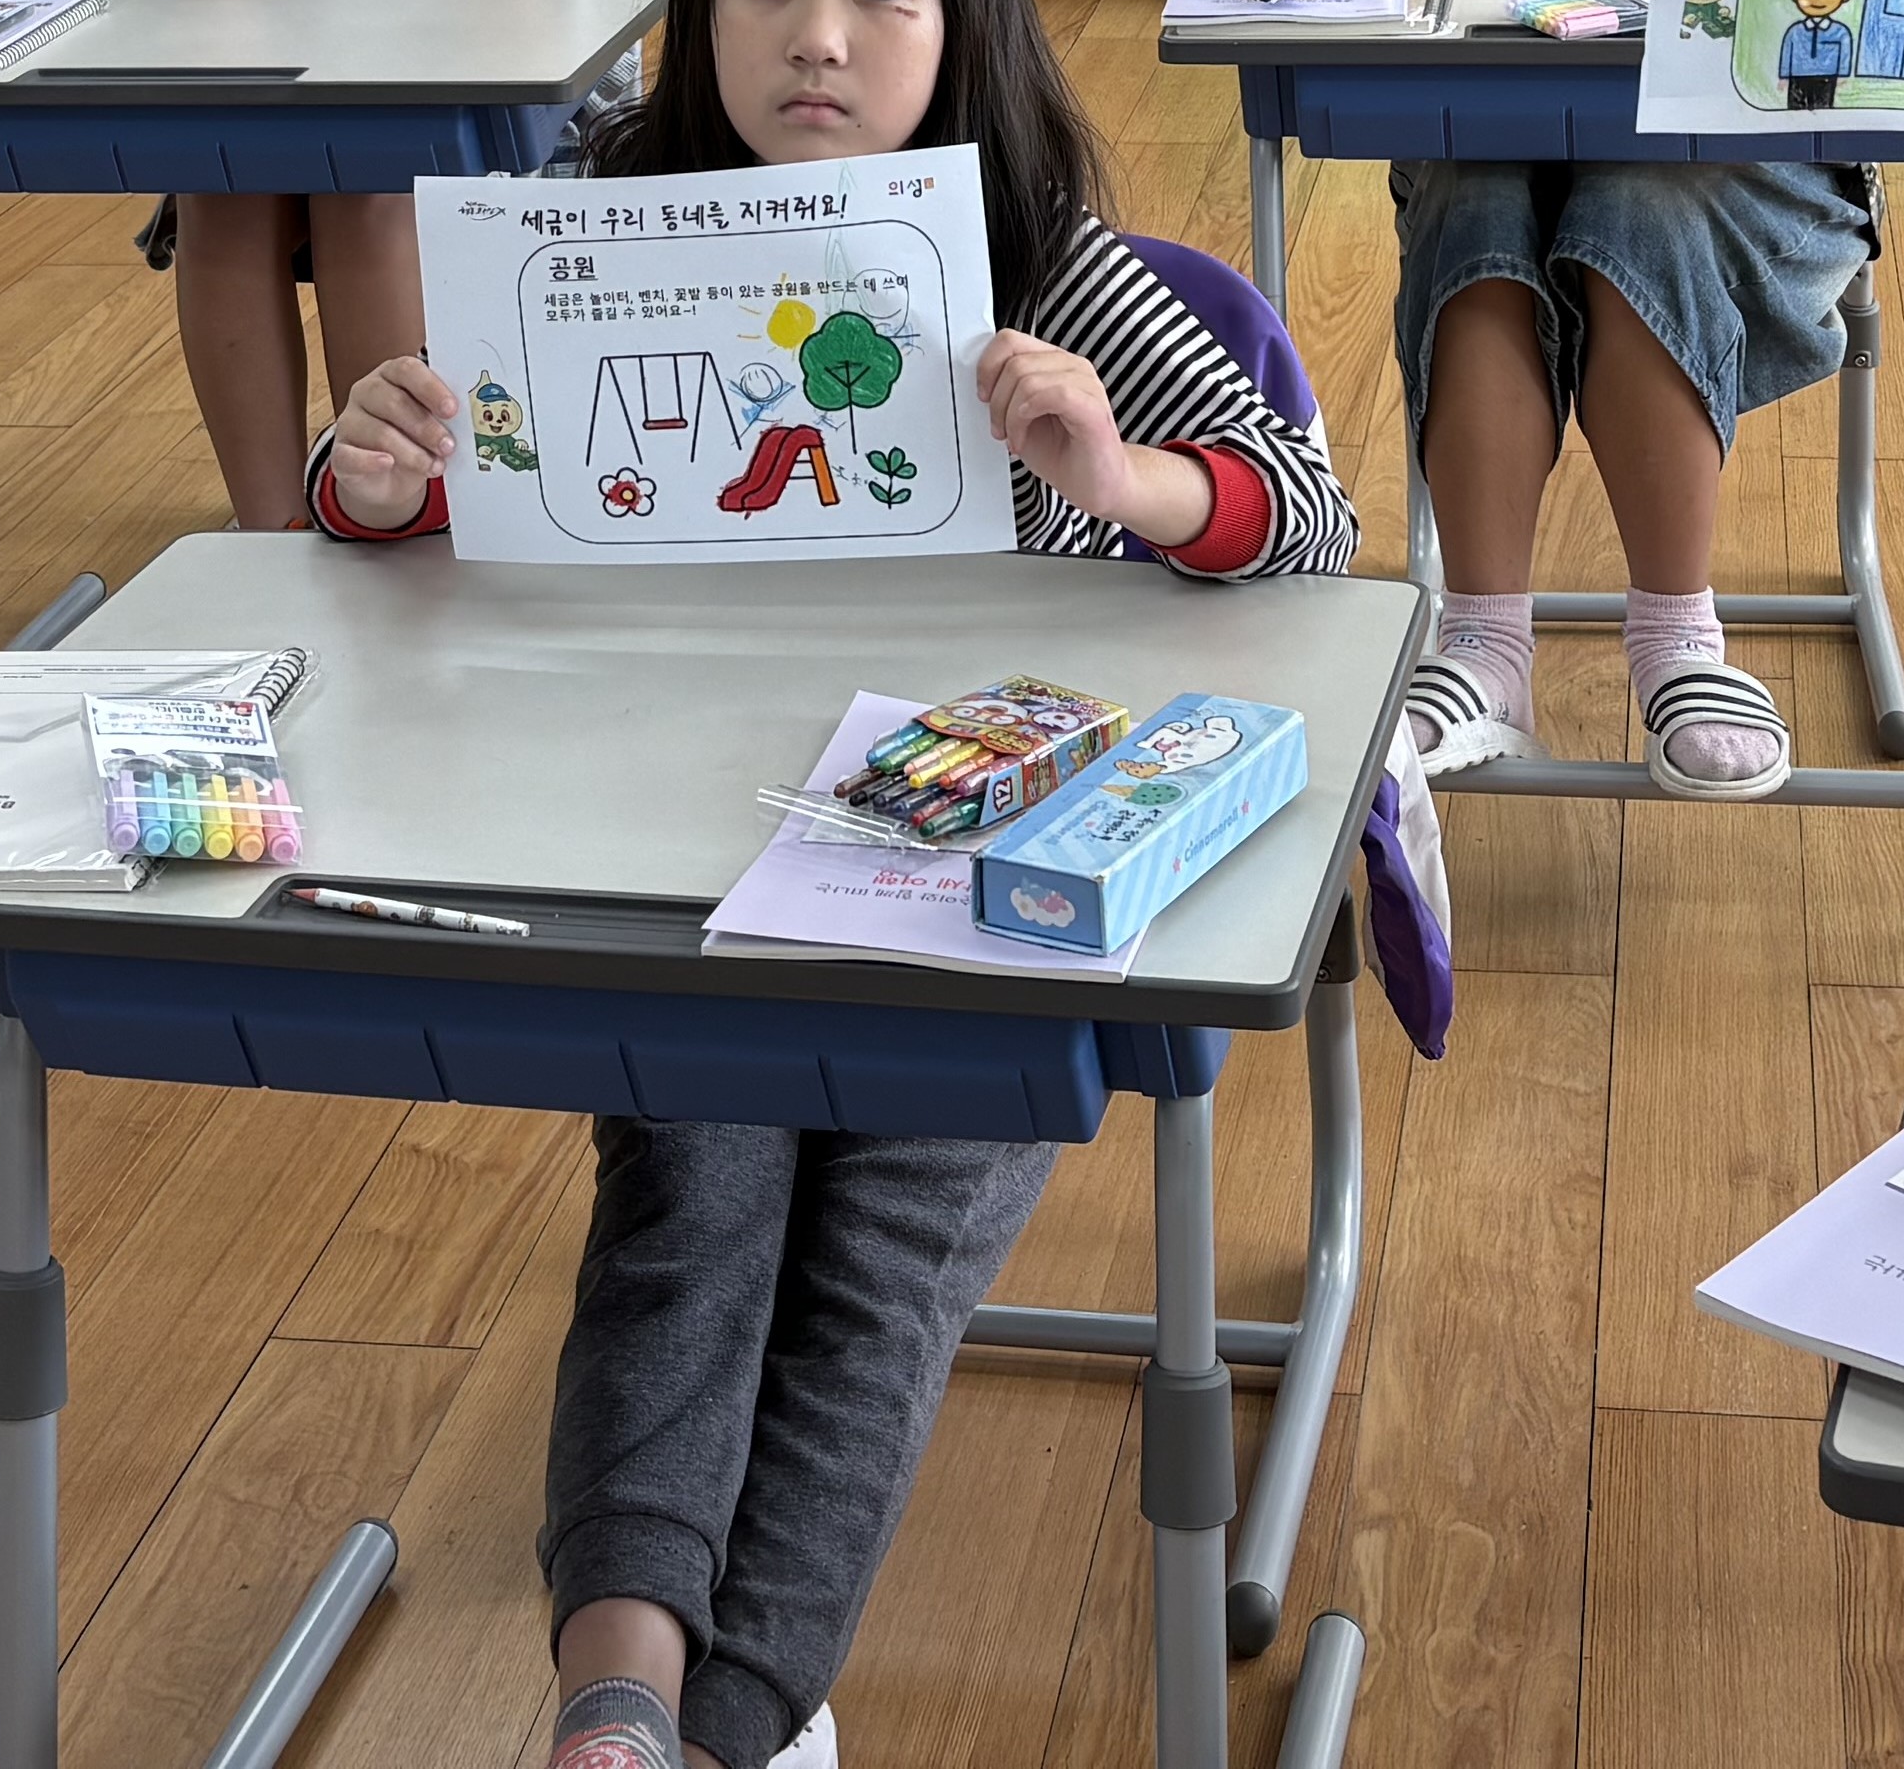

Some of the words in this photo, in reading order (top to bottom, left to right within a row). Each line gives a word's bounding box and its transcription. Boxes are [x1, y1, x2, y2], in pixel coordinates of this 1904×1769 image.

[888, 178, 923, 199] 의성
[520, 208, 587, 236] 세금이
[600, 206, 644, 234] 우리
[661, 200, 730, 230] 동네를
[549, 256, 596, 280] 공원
[545, 292, 584, 306] 세금은
[590, 290, 634, 305] 놀이터,
[638, 289, 669, 303] 벤치,
[707, 286, 733, 301] 등이
[739, 284, 766, 299] 있는
[771, 281, 812, 297] 공원을
[817, 279, 857, 295] 만드는
[863, 278, 877, 292] 데
[882, 274, 910, 291] 쓰여
[546, 308, 586, 322] 모두가
[591, 306, 617, 321] 즐길
[623, 306, 637, 320] 수
[994, 775, 1013, 812] 12
[1184, 806, 1239, 863] Cinnamoroll
